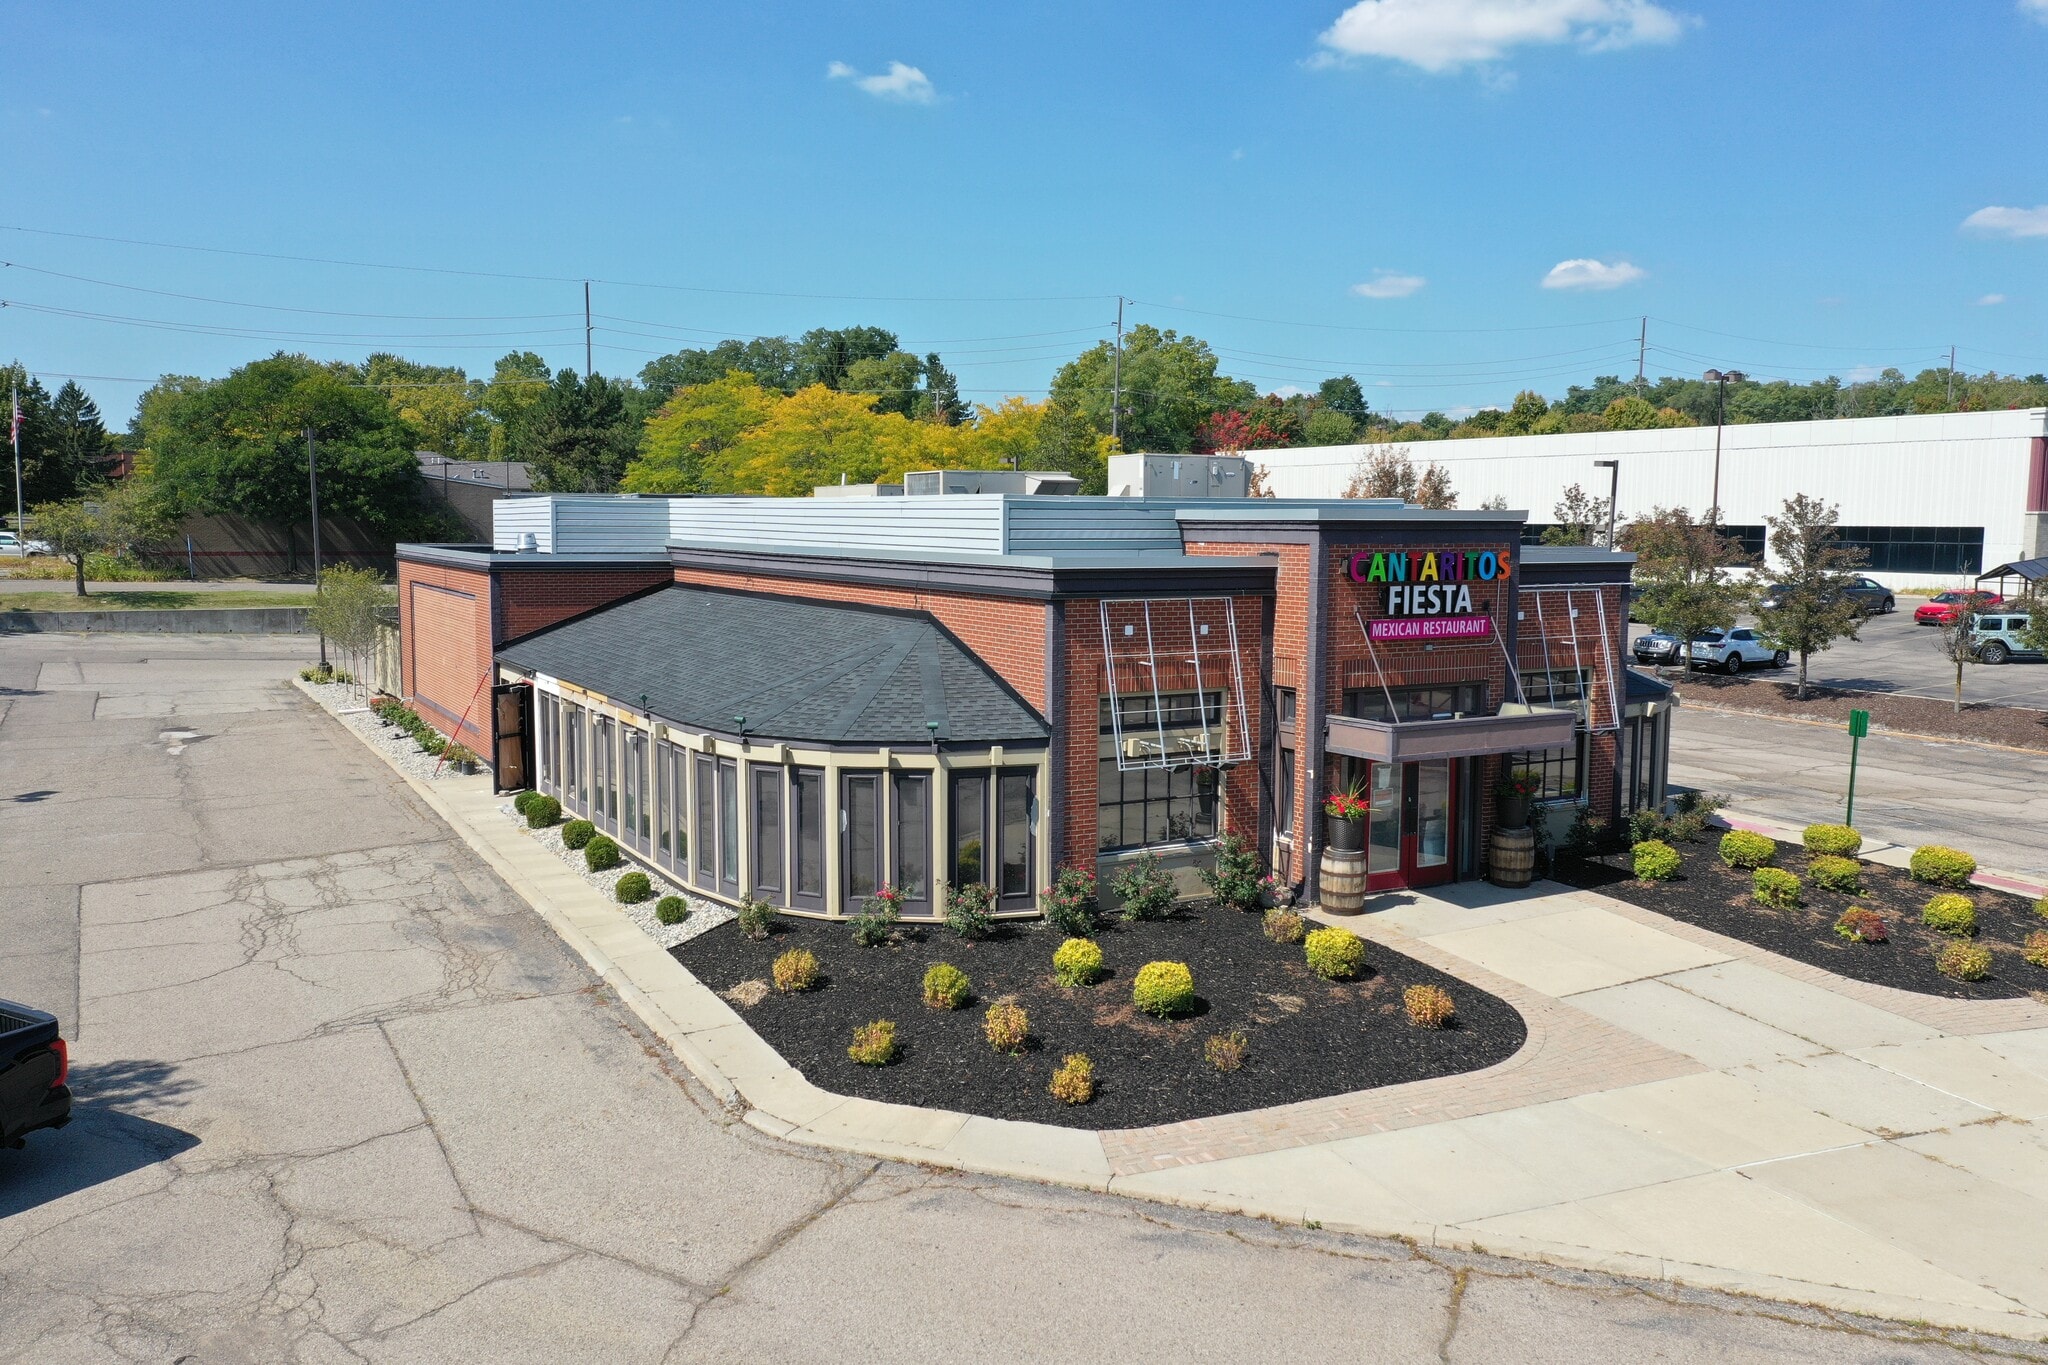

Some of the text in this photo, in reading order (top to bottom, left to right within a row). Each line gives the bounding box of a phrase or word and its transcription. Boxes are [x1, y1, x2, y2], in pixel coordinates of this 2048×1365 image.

[1350, 550, 1511, 583] CANTARITOS
[1388, 584, 1473, 616] FIESTA
[1372, 619, 1486, 637] MEXICAN RESTAURANT
